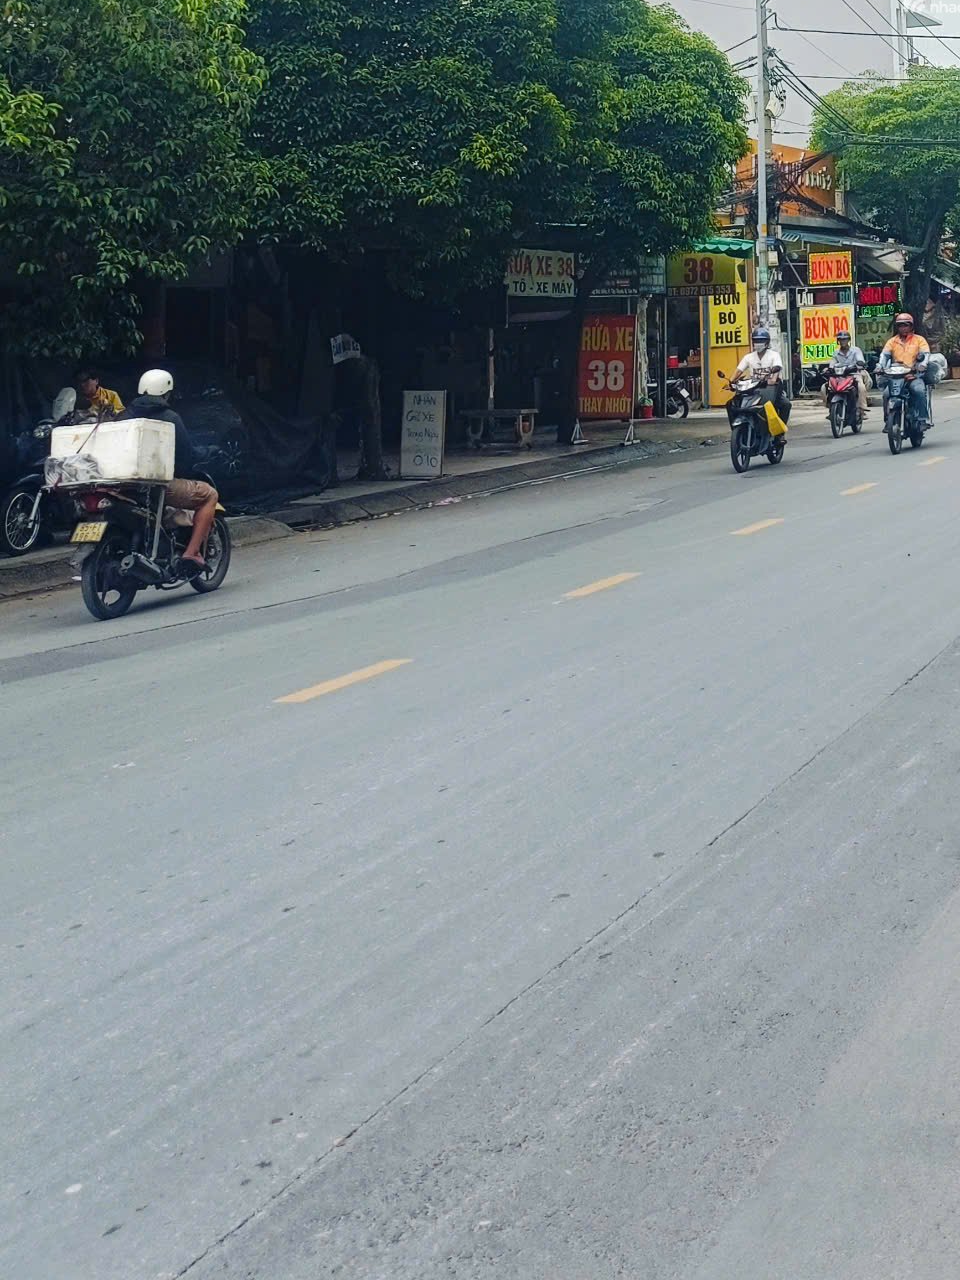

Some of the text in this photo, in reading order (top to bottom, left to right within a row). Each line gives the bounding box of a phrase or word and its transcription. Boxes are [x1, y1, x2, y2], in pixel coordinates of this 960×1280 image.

[536, 256, 553, 276] XE
[557, 257, 573, 276] 38
[684, 257, 714, 284] 38
[811, 256, 850, 280] BÚN BÒ
[536, 282, 549, 294] XE
[551, 280, 573, 294] MÁY
[718, 308, 737, 325] BÒ
[804, 310, 829, 339] BÚN
[615, 327, 633, 351] XE
[715, 325, 742, 344] HUẾ
[587, 360, 625, 391] 38
[579, 393, 632, 413] THAY NHỚT
